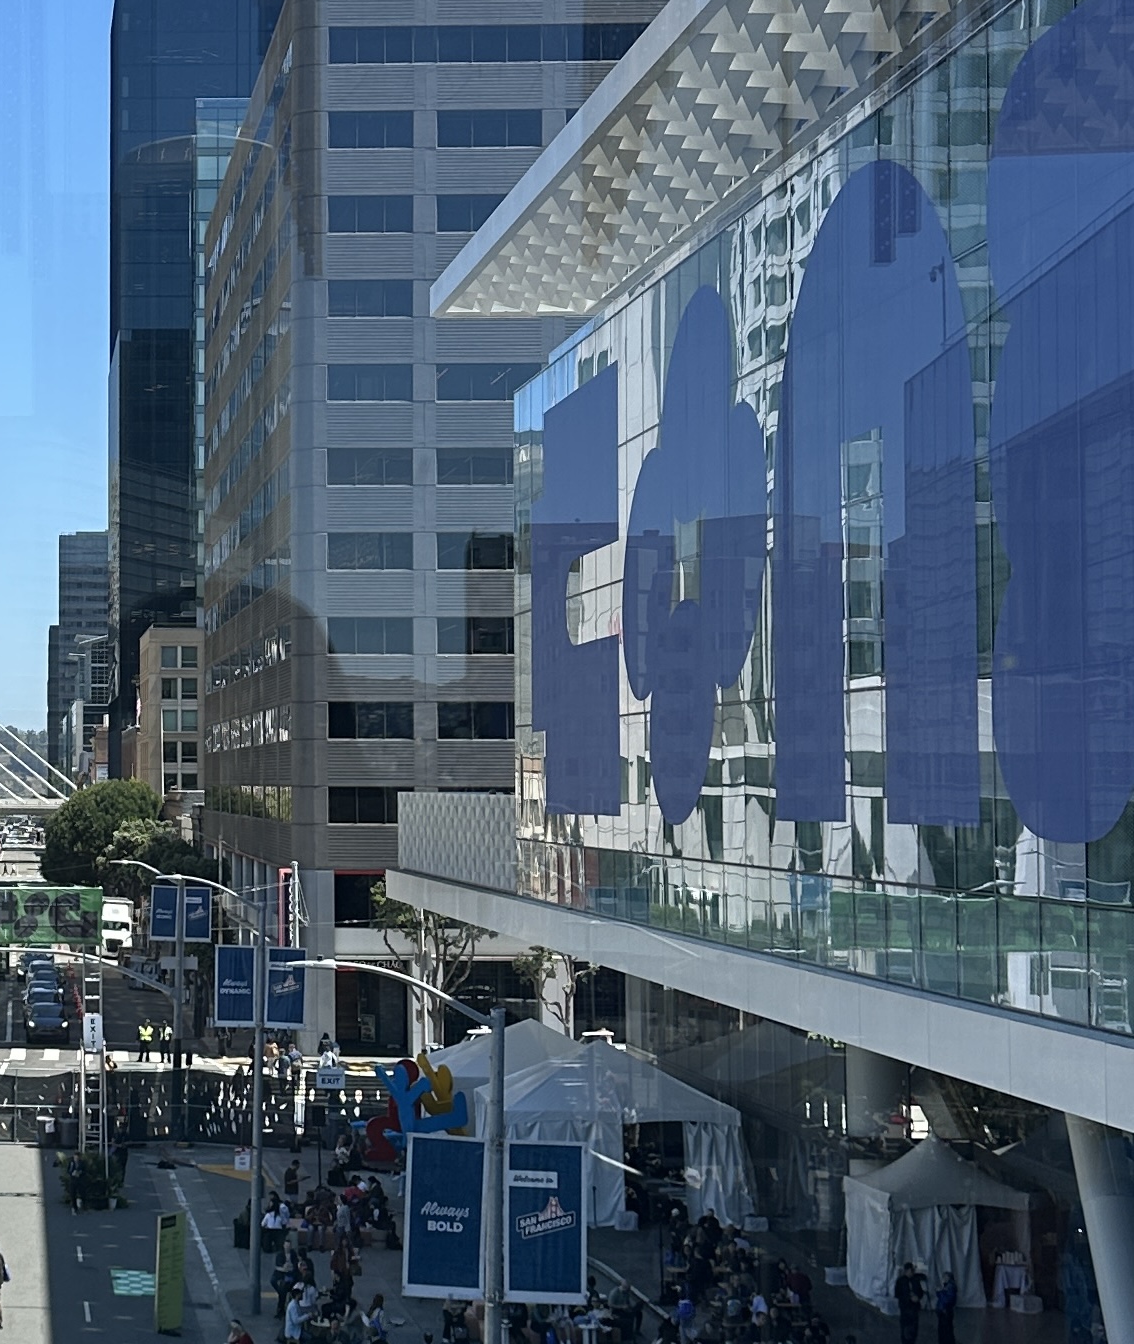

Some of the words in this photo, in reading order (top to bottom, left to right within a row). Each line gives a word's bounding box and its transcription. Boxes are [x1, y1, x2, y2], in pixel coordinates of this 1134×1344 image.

[321, 1077, 341, 1085] EXIT
[513, 1174, 544, 1184] Welcome
[421, 1201, 470, 1221] Always
[427, 1220, 464, 1233] BOLD
[519, 1215, 537, 1228] SAN
[525, 1214, 572, 1236] FRANCISCO
